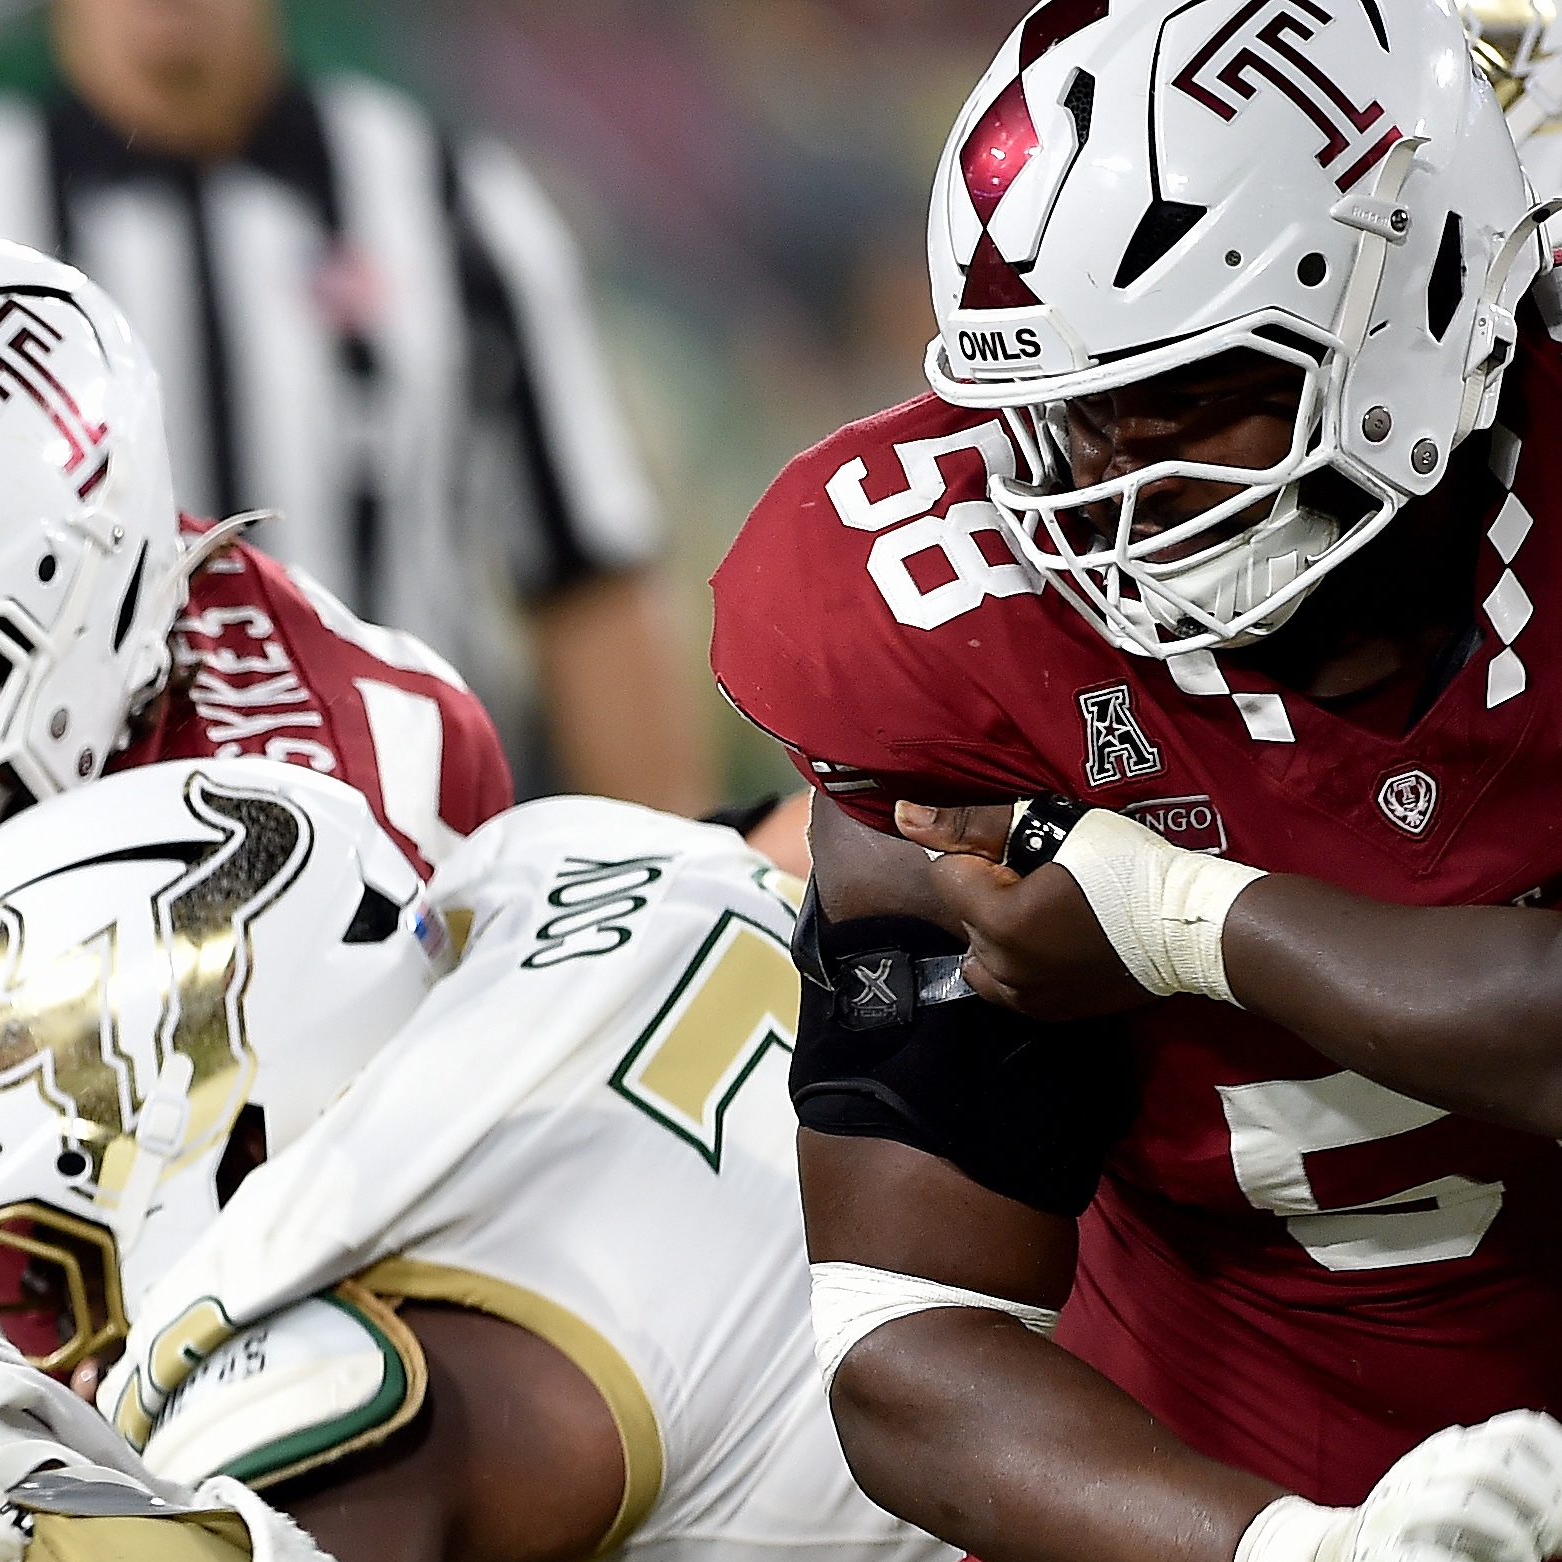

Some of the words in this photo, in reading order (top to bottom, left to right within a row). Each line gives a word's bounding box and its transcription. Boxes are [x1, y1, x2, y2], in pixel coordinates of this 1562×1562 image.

[1170, 0, 1404, 193] T
[958, 329, 1042, 361] OWLS
[824, 418, 1048, 631] 58
[1078, 684, 1162, 787] A
[1134, 805, 1212, 835] NGO
[520, 851, 674, 969] COOK
